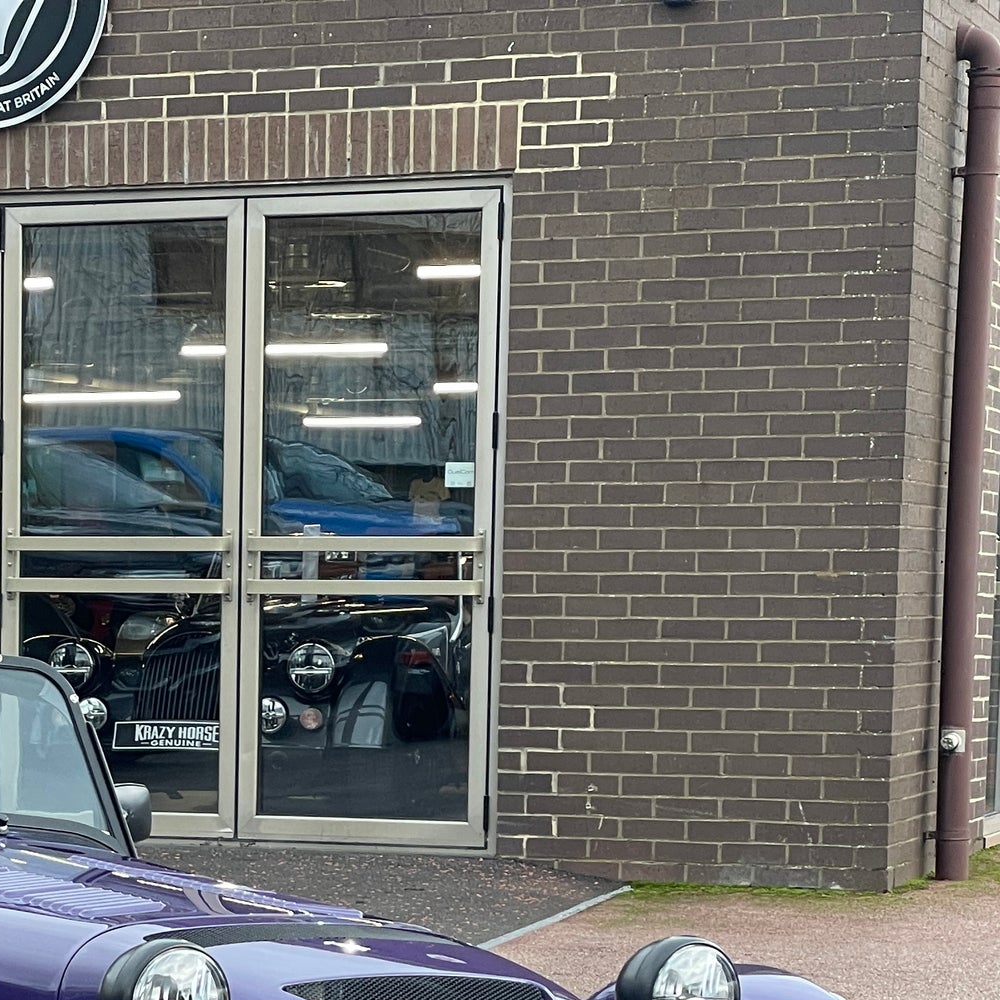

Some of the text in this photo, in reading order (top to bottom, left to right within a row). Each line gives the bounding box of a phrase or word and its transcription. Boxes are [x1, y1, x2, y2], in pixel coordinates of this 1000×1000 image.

[14, 71, 61, 109] BRITAIN
[135, 724, 219, 743] KRAZY HORSE
